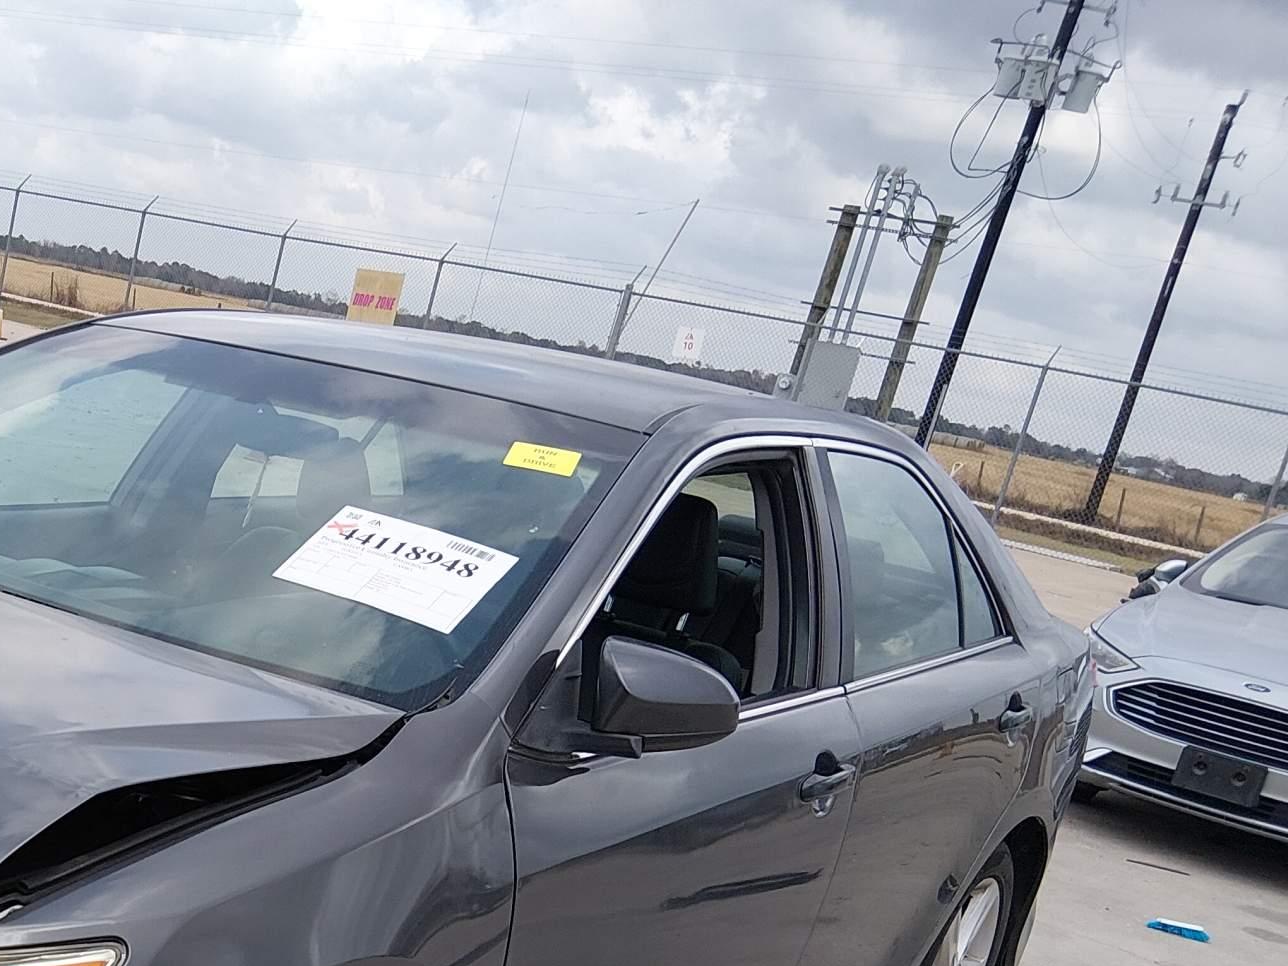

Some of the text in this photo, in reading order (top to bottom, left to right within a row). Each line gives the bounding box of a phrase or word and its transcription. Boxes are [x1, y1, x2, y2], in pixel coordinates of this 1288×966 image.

[352, 293, 396, 310] DROP ZONE
[684, 341, 693, 351] 10
[339, 528, 479, 578] 44118948
